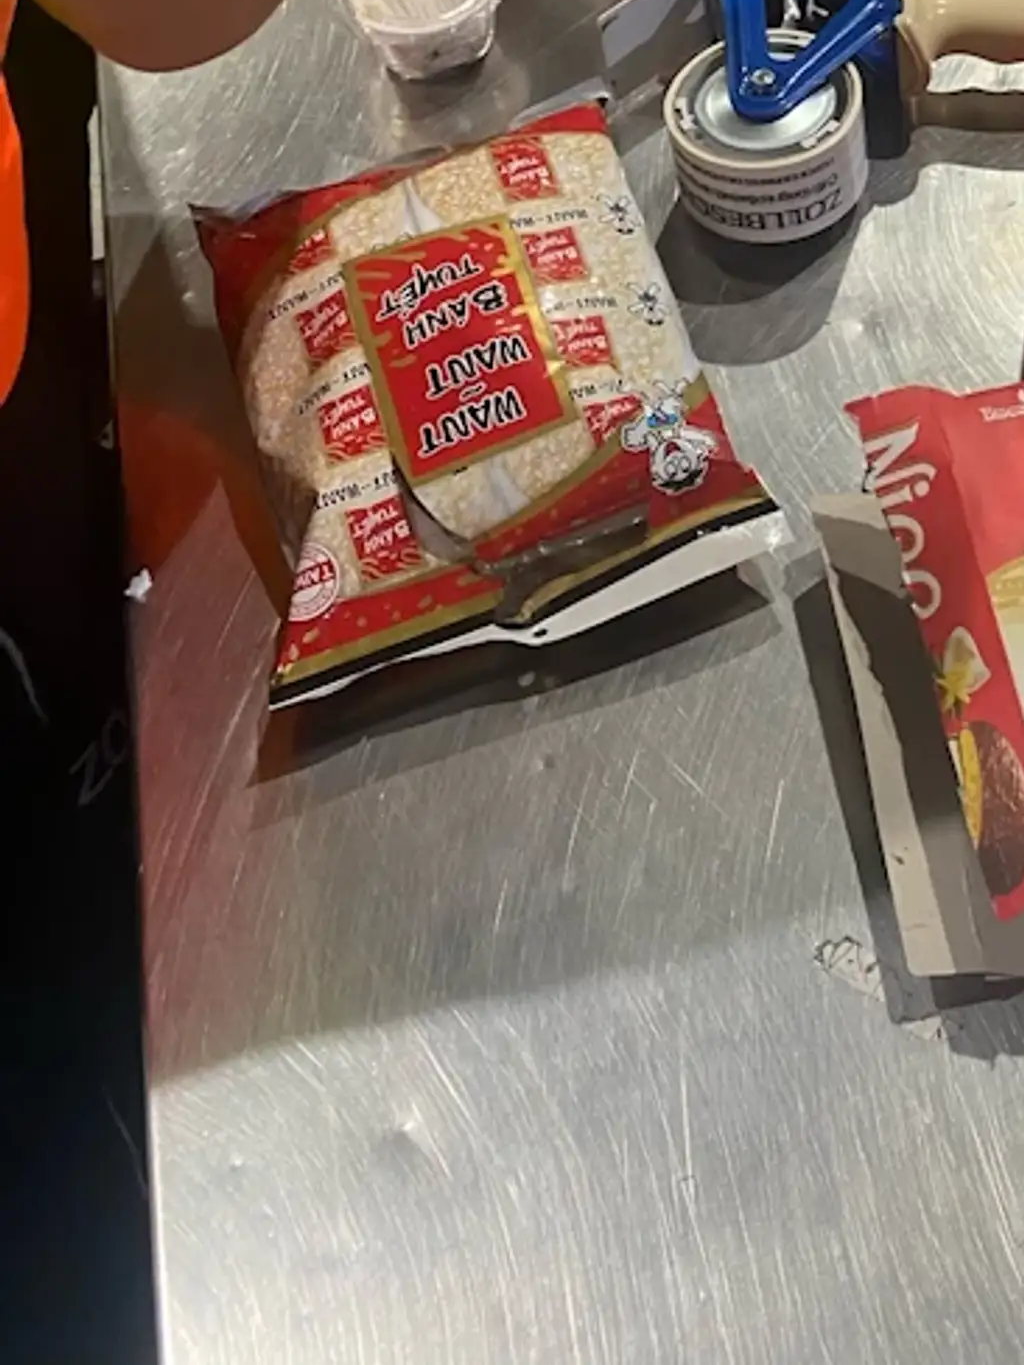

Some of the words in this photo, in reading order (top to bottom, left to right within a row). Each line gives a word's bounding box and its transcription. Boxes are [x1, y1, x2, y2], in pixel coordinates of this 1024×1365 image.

[401, 276, 509, 350] BÁNH
[422, 330, 534, 401] WANT
[418, 386, 528, 459] WANT
